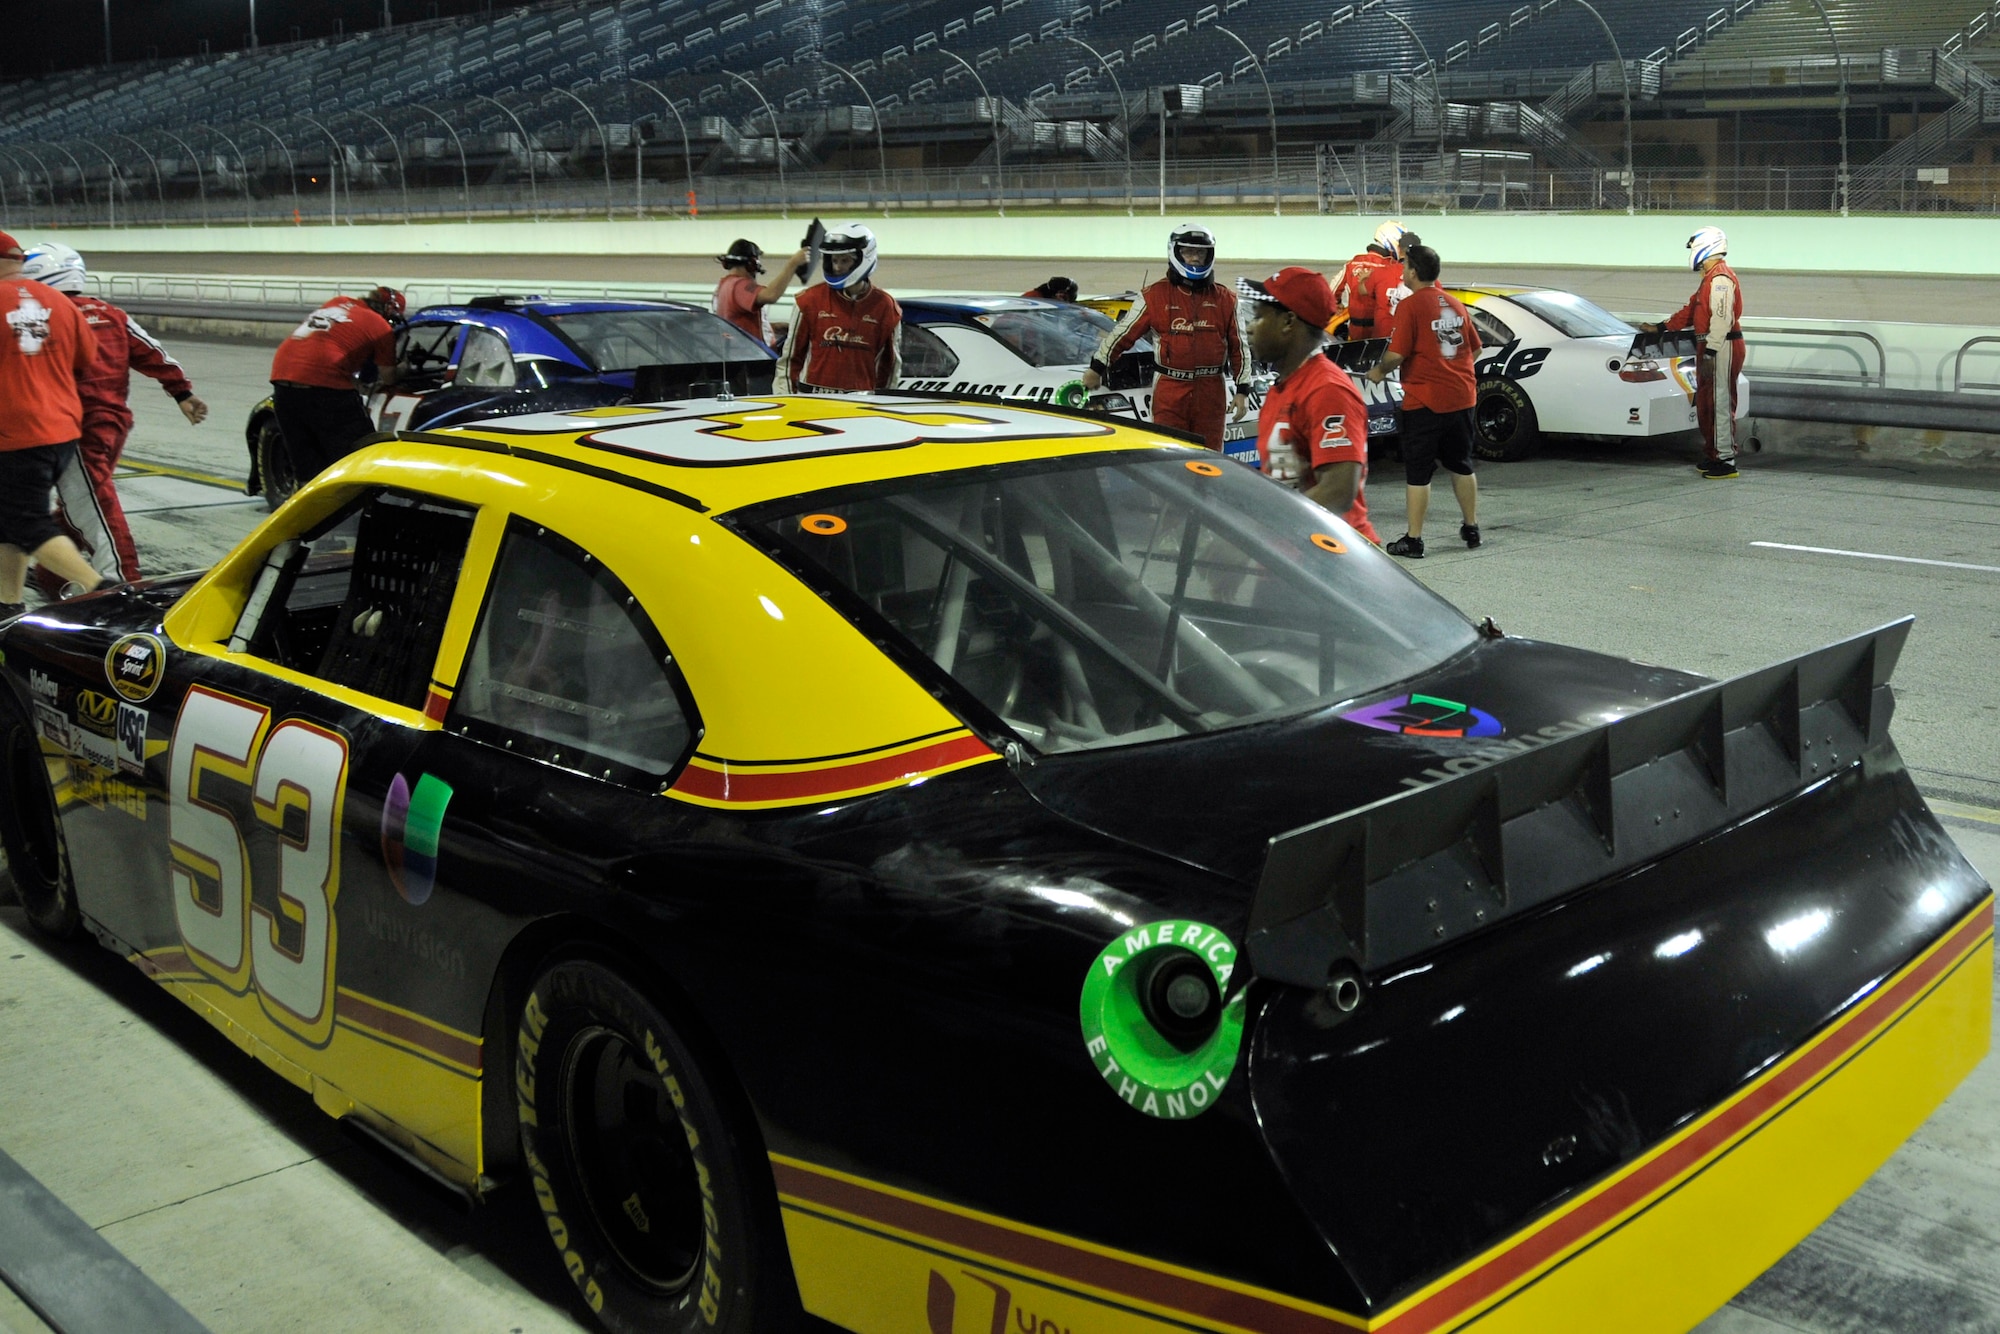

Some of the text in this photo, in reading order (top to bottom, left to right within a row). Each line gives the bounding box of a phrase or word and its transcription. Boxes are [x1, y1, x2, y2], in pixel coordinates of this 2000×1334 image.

[1431, 316, 1464, 331] CREW
[120, 658, 145, 677] Sprint
[30, 668, 59, 706] Holley
[119, 706, 145, 764] USG
[82, 743, 115, 771] freescale
[168, 684, 350, 1032] 53
[1086, 1035, 1226, 1118] ETHANOL
[644, 1028, 722, 1326] WRANGLER
[627, 1202, 647, 1228] AERO
